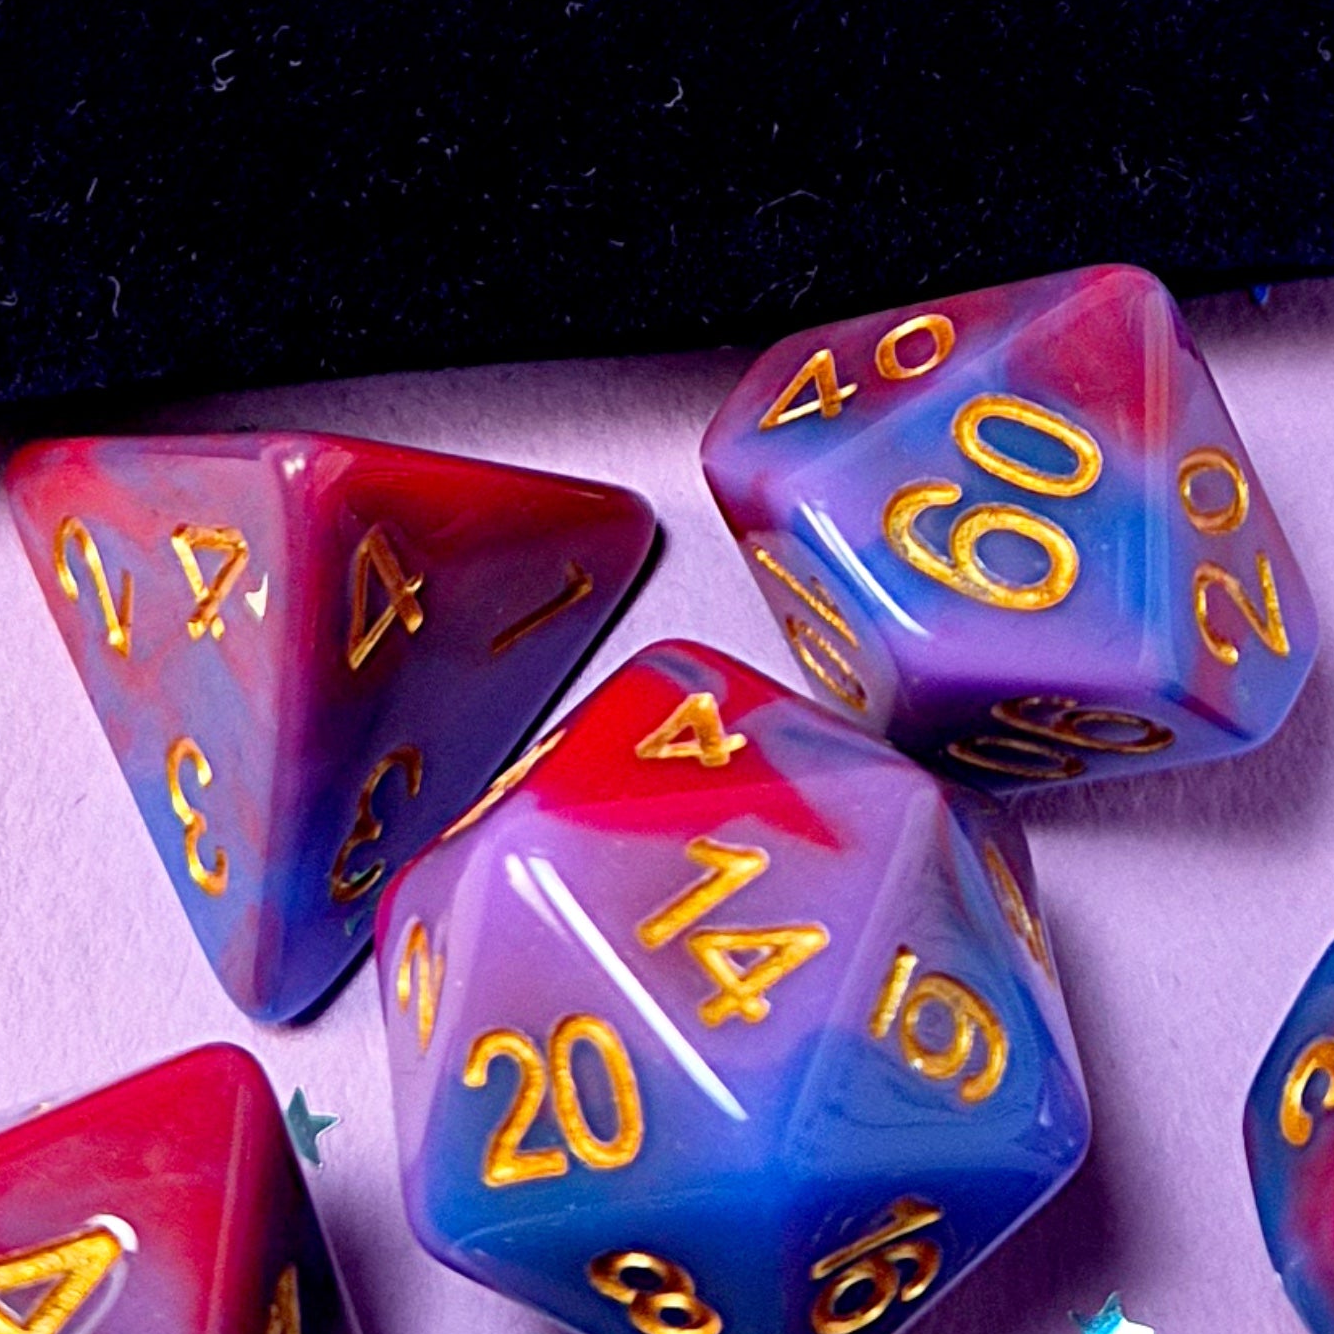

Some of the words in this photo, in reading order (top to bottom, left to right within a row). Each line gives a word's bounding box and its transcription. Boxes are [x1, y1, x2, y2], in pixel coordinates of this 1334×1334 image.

[759, 314, 956, 430] 40
[883, 393, 1103, 611] 60
[171, 521, 250, 641] 4
[349, 524, 424, 670] 4
[634, 691, 748, 767] 4
[636, 834, 831, 1027] 14
[463, 1012, 646, 1187] 20
